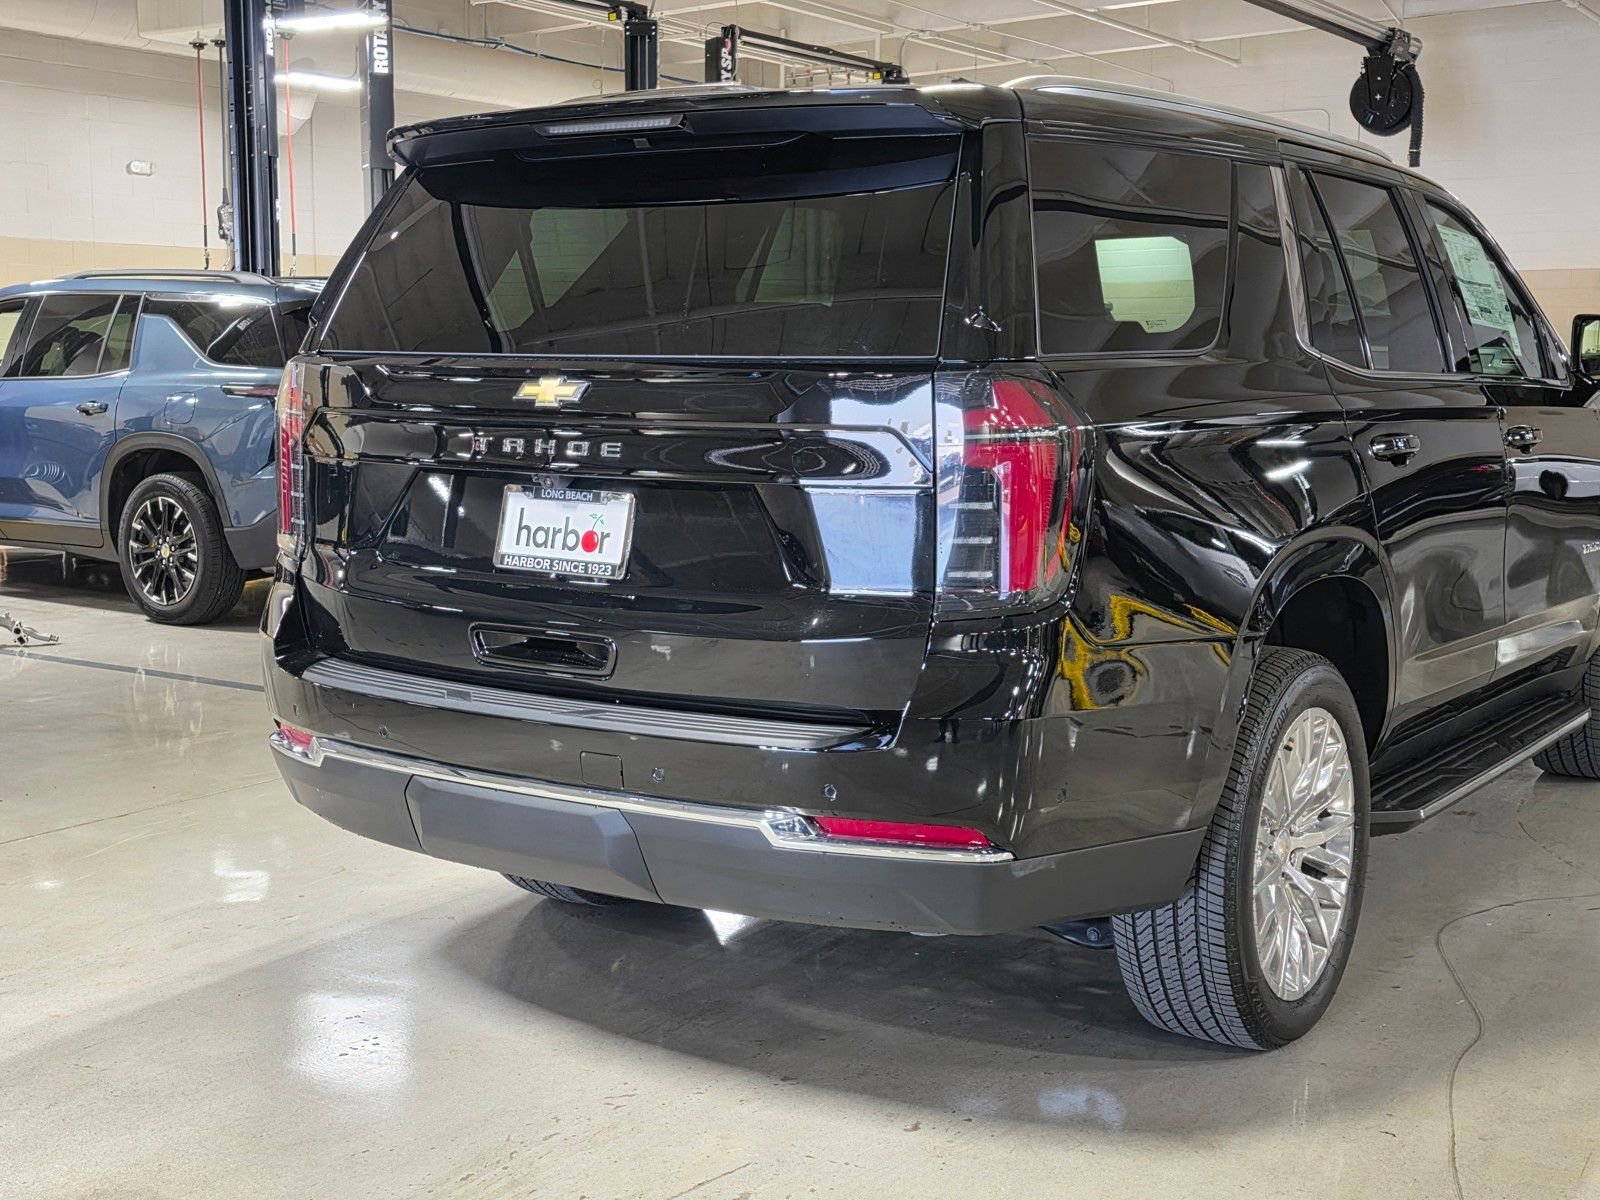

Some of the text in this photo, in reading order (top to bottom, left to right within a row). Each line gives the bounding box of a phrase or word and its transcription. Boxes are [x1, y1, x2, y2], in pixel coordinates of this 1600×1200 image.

[474, 435, 622, 458] TAHOE
[541, 488, 593, 502] LONG BEACH
[515, 507, 611, 554] harbor
[504, 554, 612, 576] HARBOR SINCE 1923
